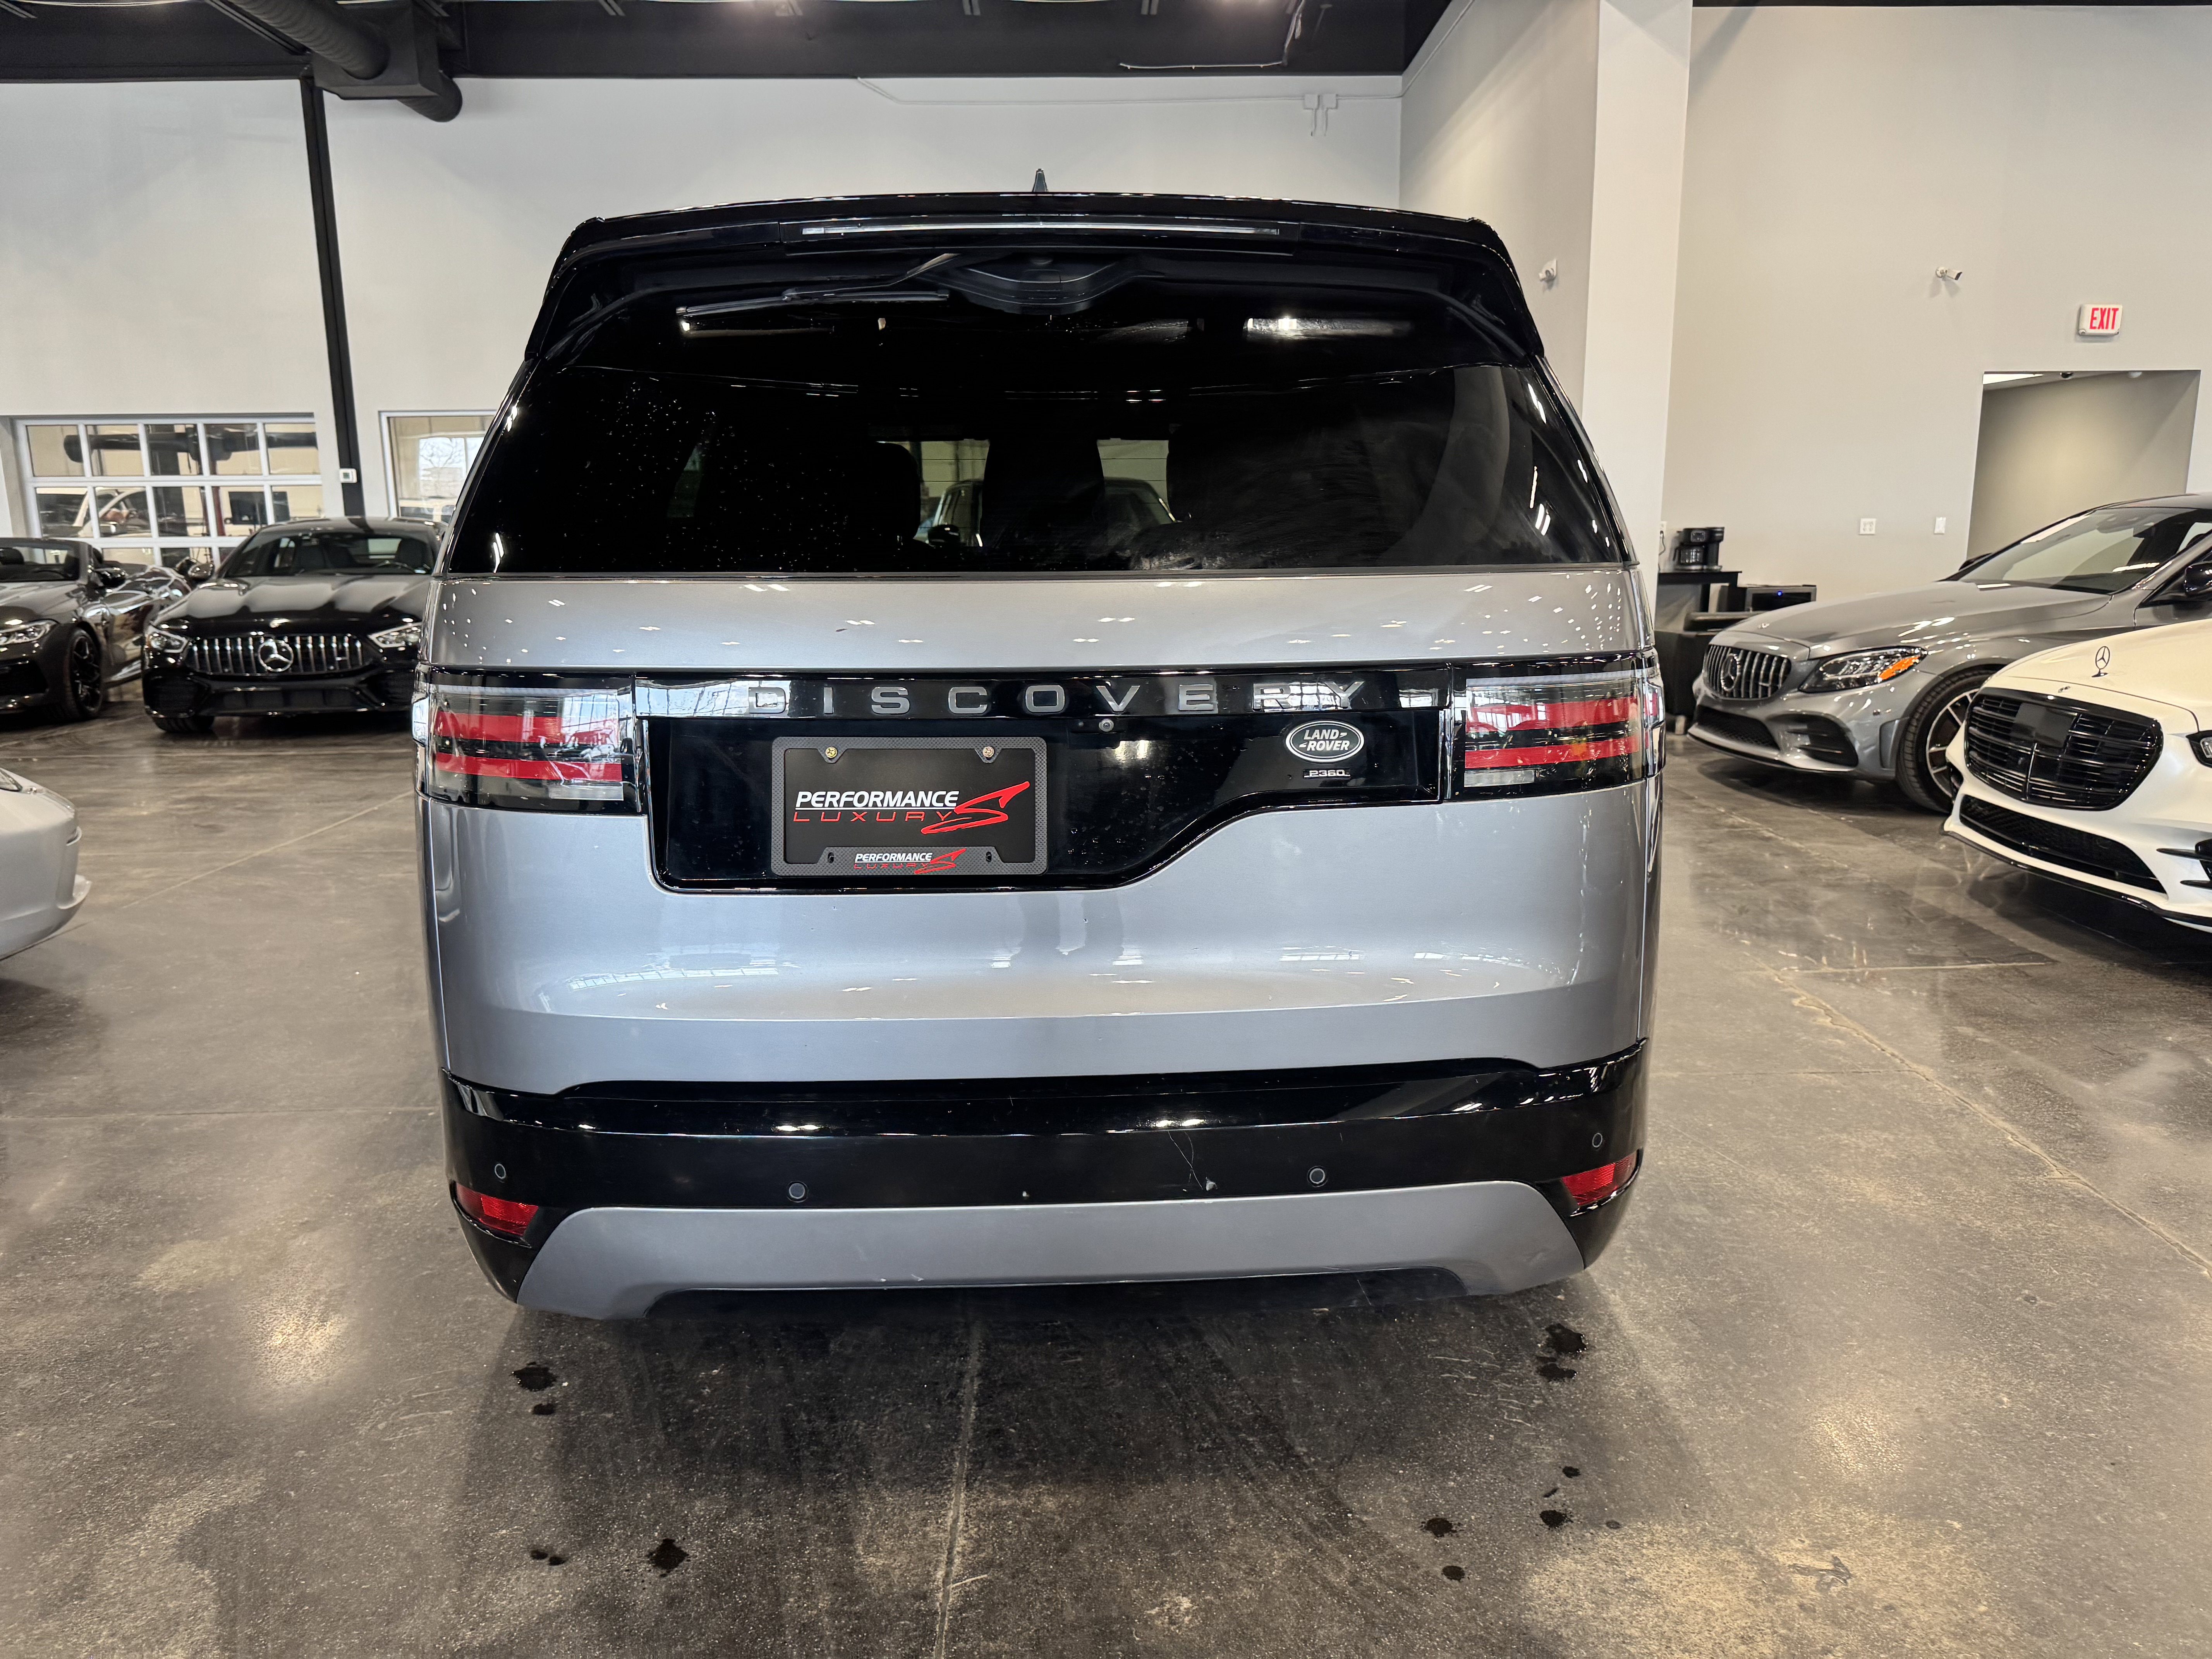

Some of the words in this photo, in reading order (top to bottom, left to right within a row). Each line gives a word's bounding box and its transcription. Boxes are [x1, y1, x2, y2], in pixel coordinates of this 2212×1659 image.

[2090, 307, 2119, 329] EXIT
[748, 680, 1365, 714] DISCOVERY
[1304, 729, 1340, 740] LAND
[1307, 740, 1350, 751] ROVER
[795, 790, 960, 808] PERFORMANCE
[793, 811, 953, 822] LUXURY
[855, 852, 933, 862] PERFORMANCE
